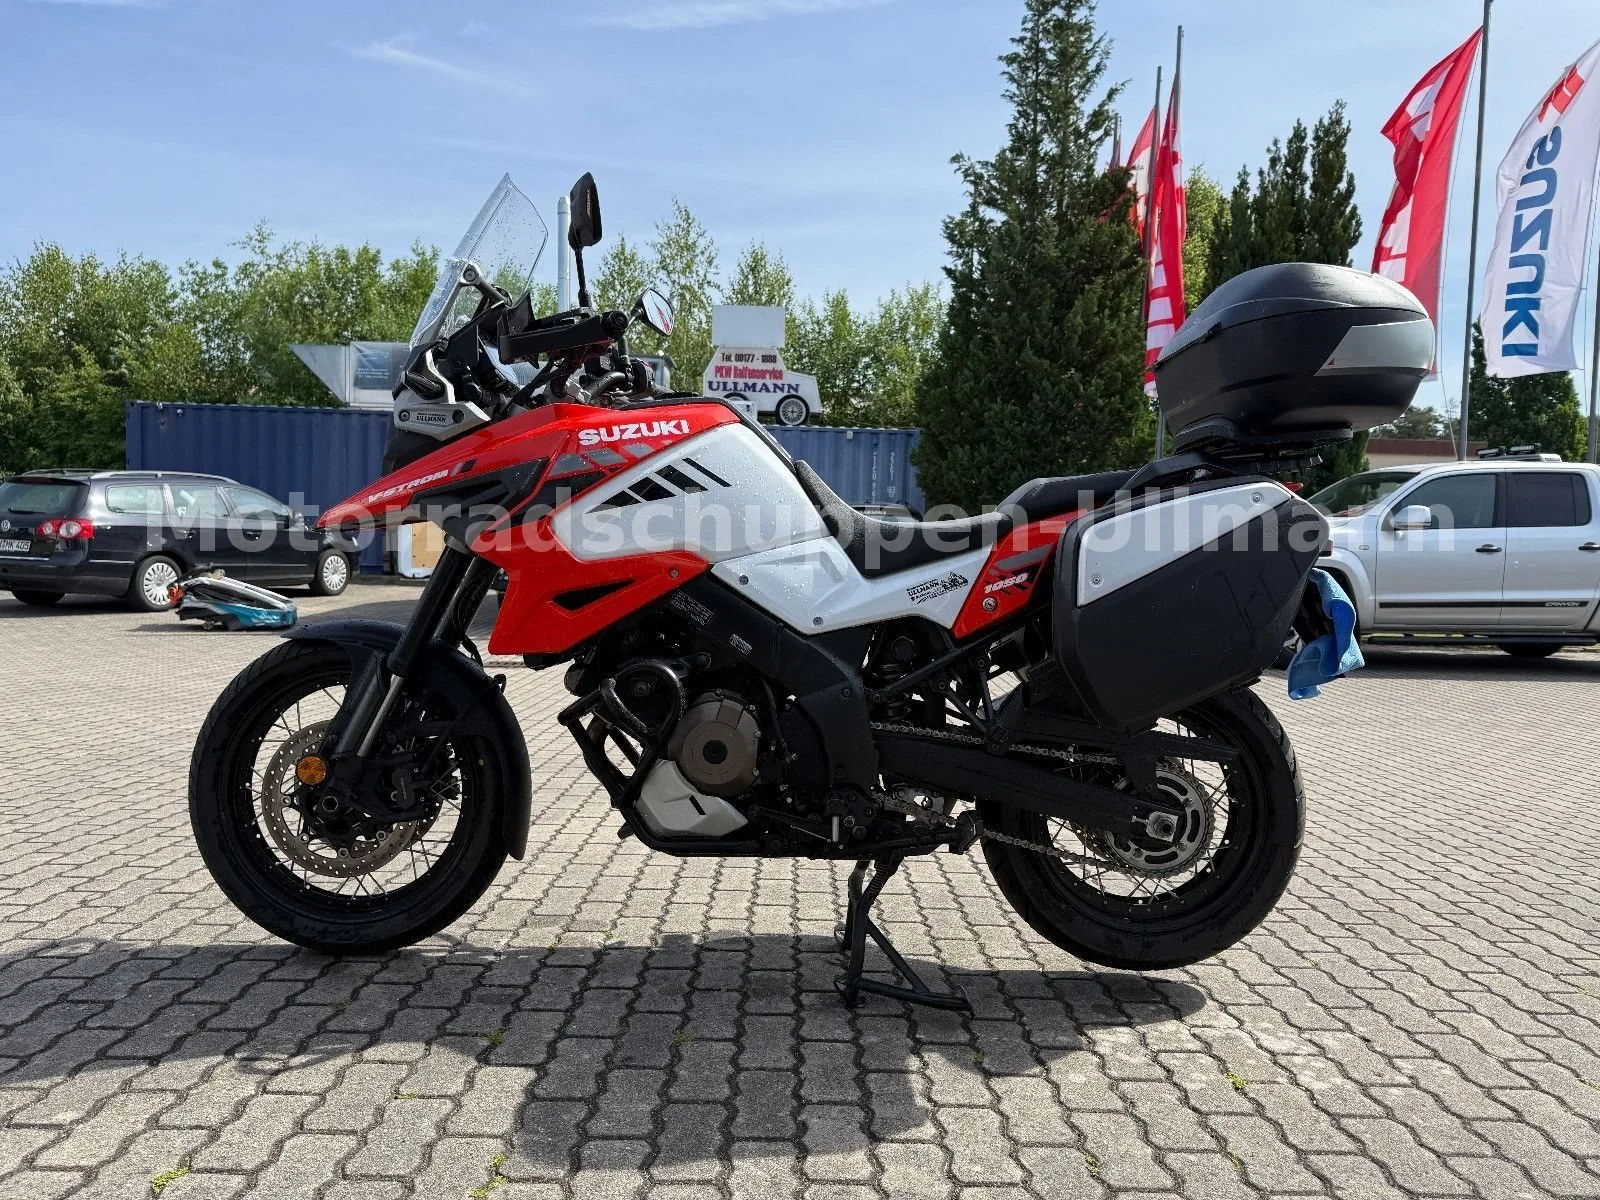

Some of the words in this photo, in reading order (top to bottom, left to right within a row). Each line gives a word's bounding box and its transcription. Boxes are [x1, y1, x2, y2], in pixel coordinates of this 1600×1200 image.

[714, 365, 732, 379] PKW
[707, 380, 800, 394] ULLMANN
[416, 415, 447, 424] ULLMANN
[578, 419, 690, 447] SUZUKI
[984, 572, 1030, 594] 1050
